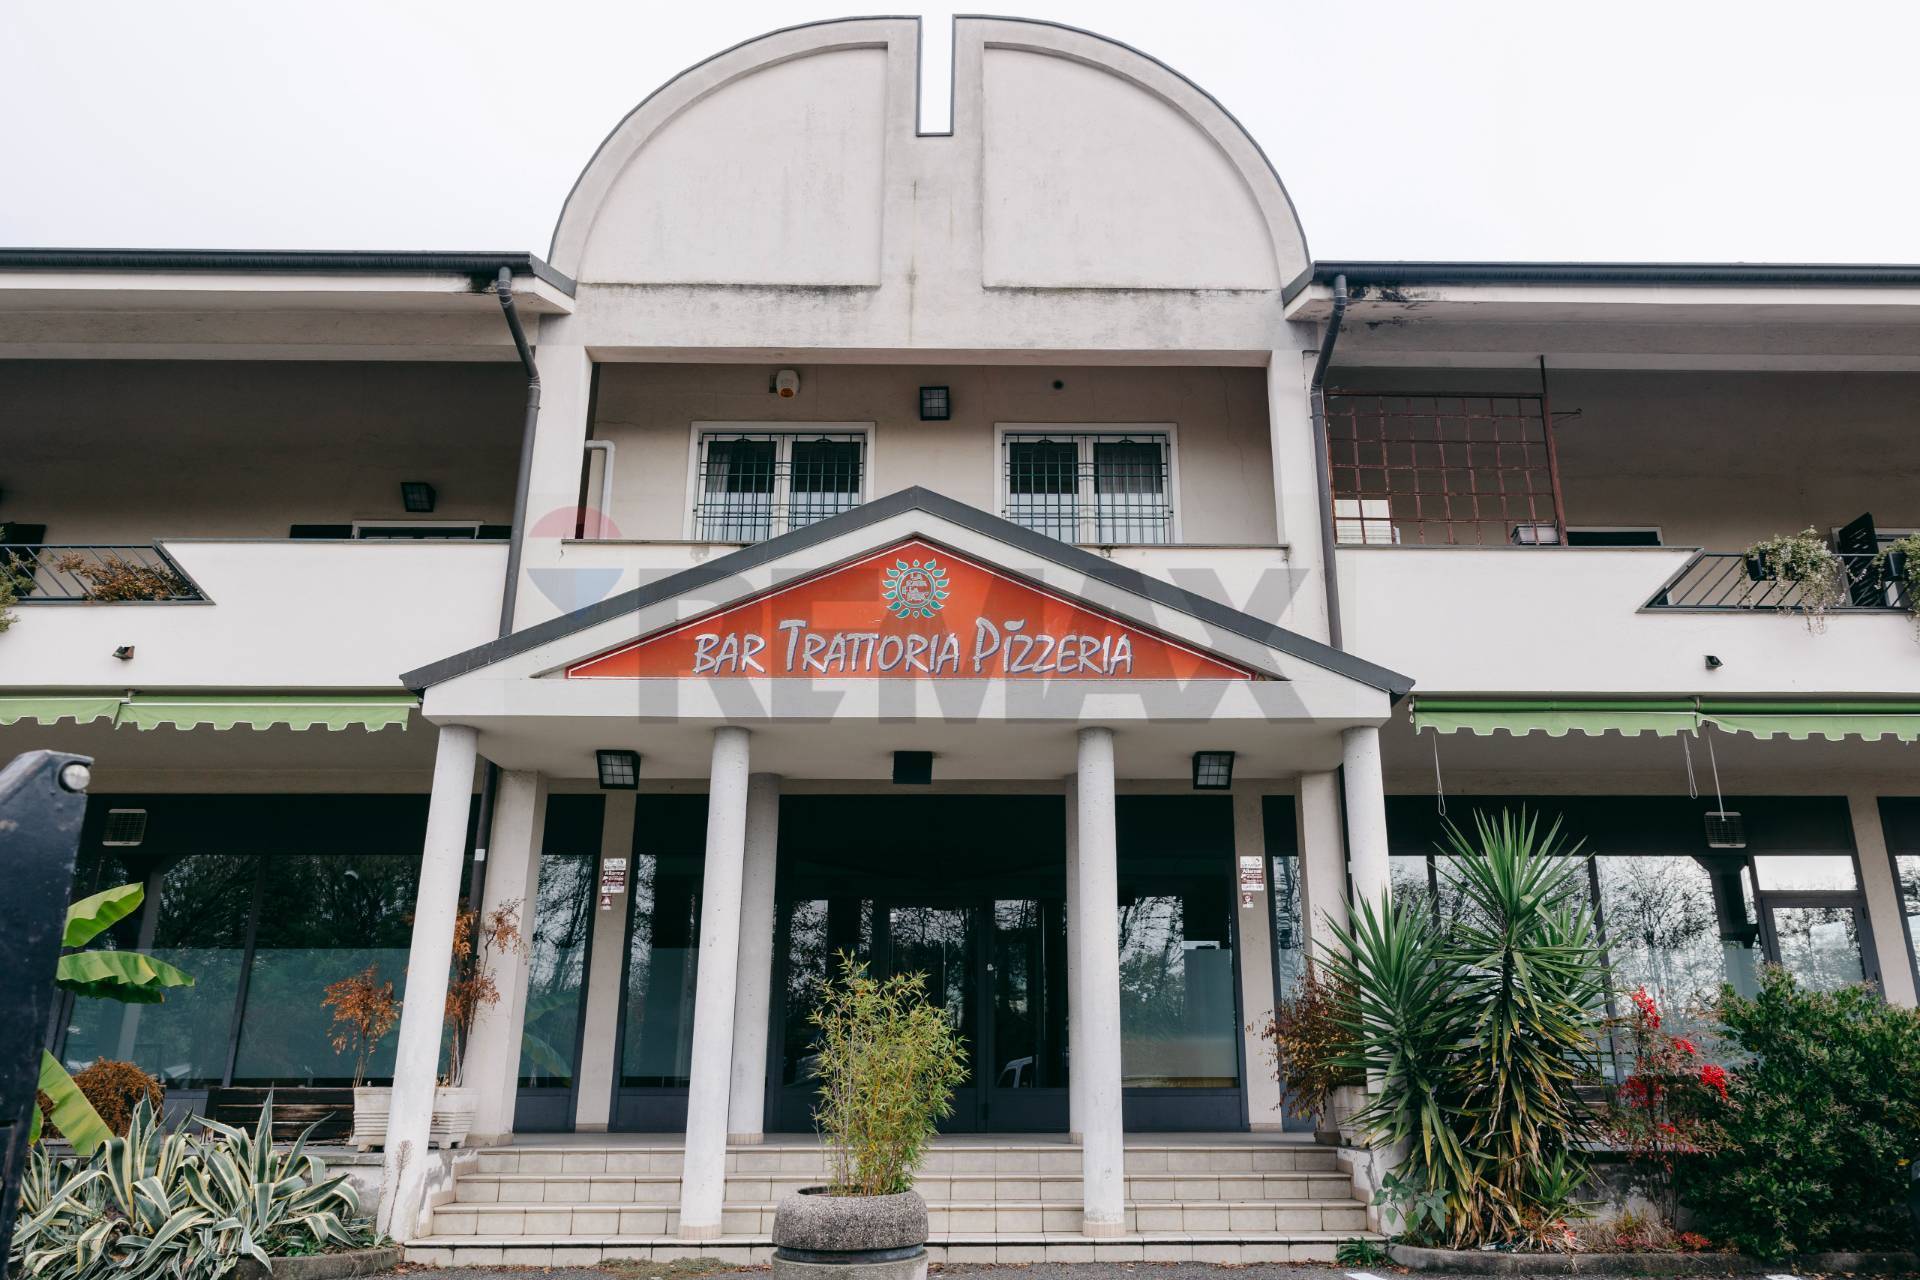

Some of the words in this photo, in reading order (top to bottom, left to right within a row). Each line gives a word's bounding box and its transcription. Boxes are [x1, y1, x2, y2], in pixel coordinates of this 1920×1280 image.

[692, 632, 766, 674] BAR
[778, 619, 960, 675] TRATTORIA
[972, 616, 1134, 675] PIZZERIA
